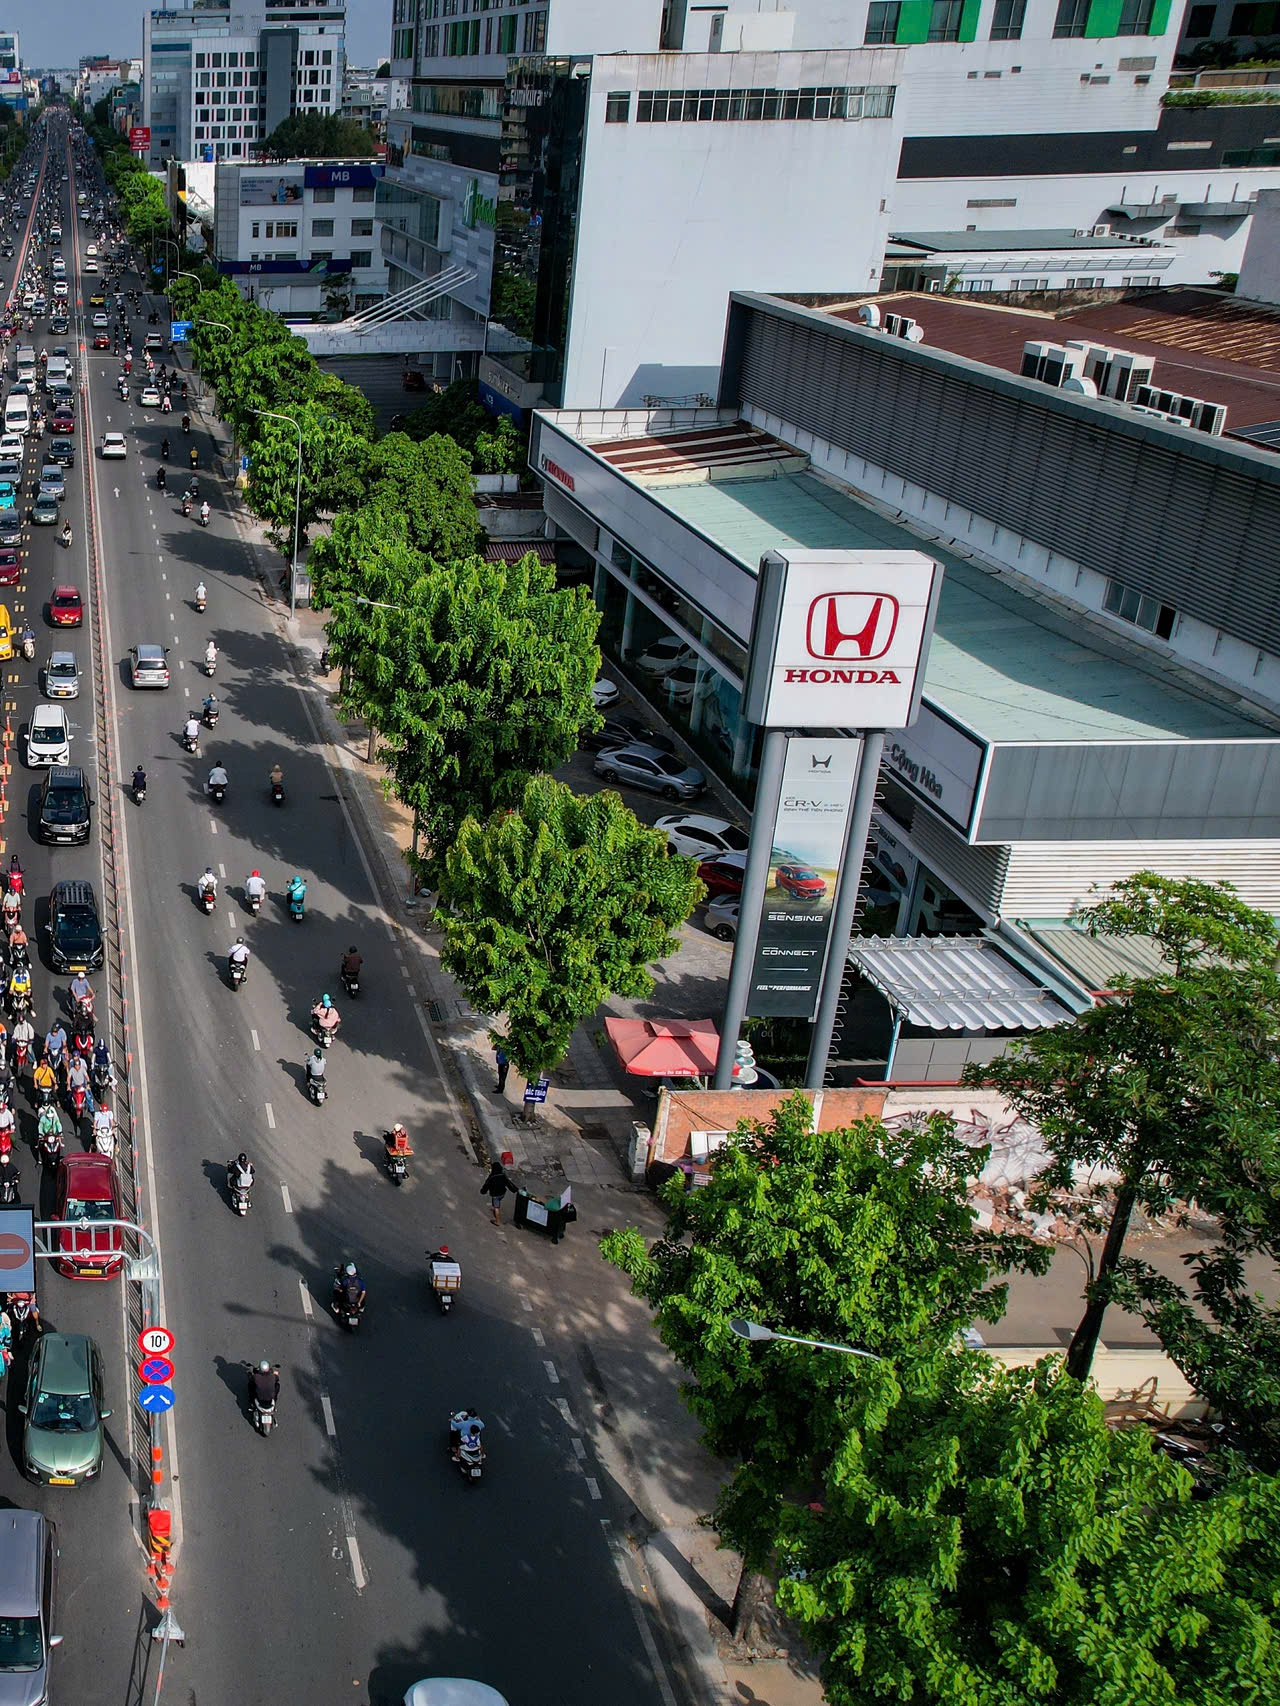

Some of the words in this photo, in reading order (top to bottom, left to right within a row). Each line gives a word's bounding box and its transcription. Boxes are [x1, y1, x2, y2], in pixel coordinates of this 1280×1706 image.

[331, 171, 351, 182] MB
[250, 264, 262, 272] MB
[547, 459, 576, 493] HONDA
[783, 669, 902, 684] HONDA
[890, 743, 919, 783] Cộng
[920, 766, 943, 801] Hòa
